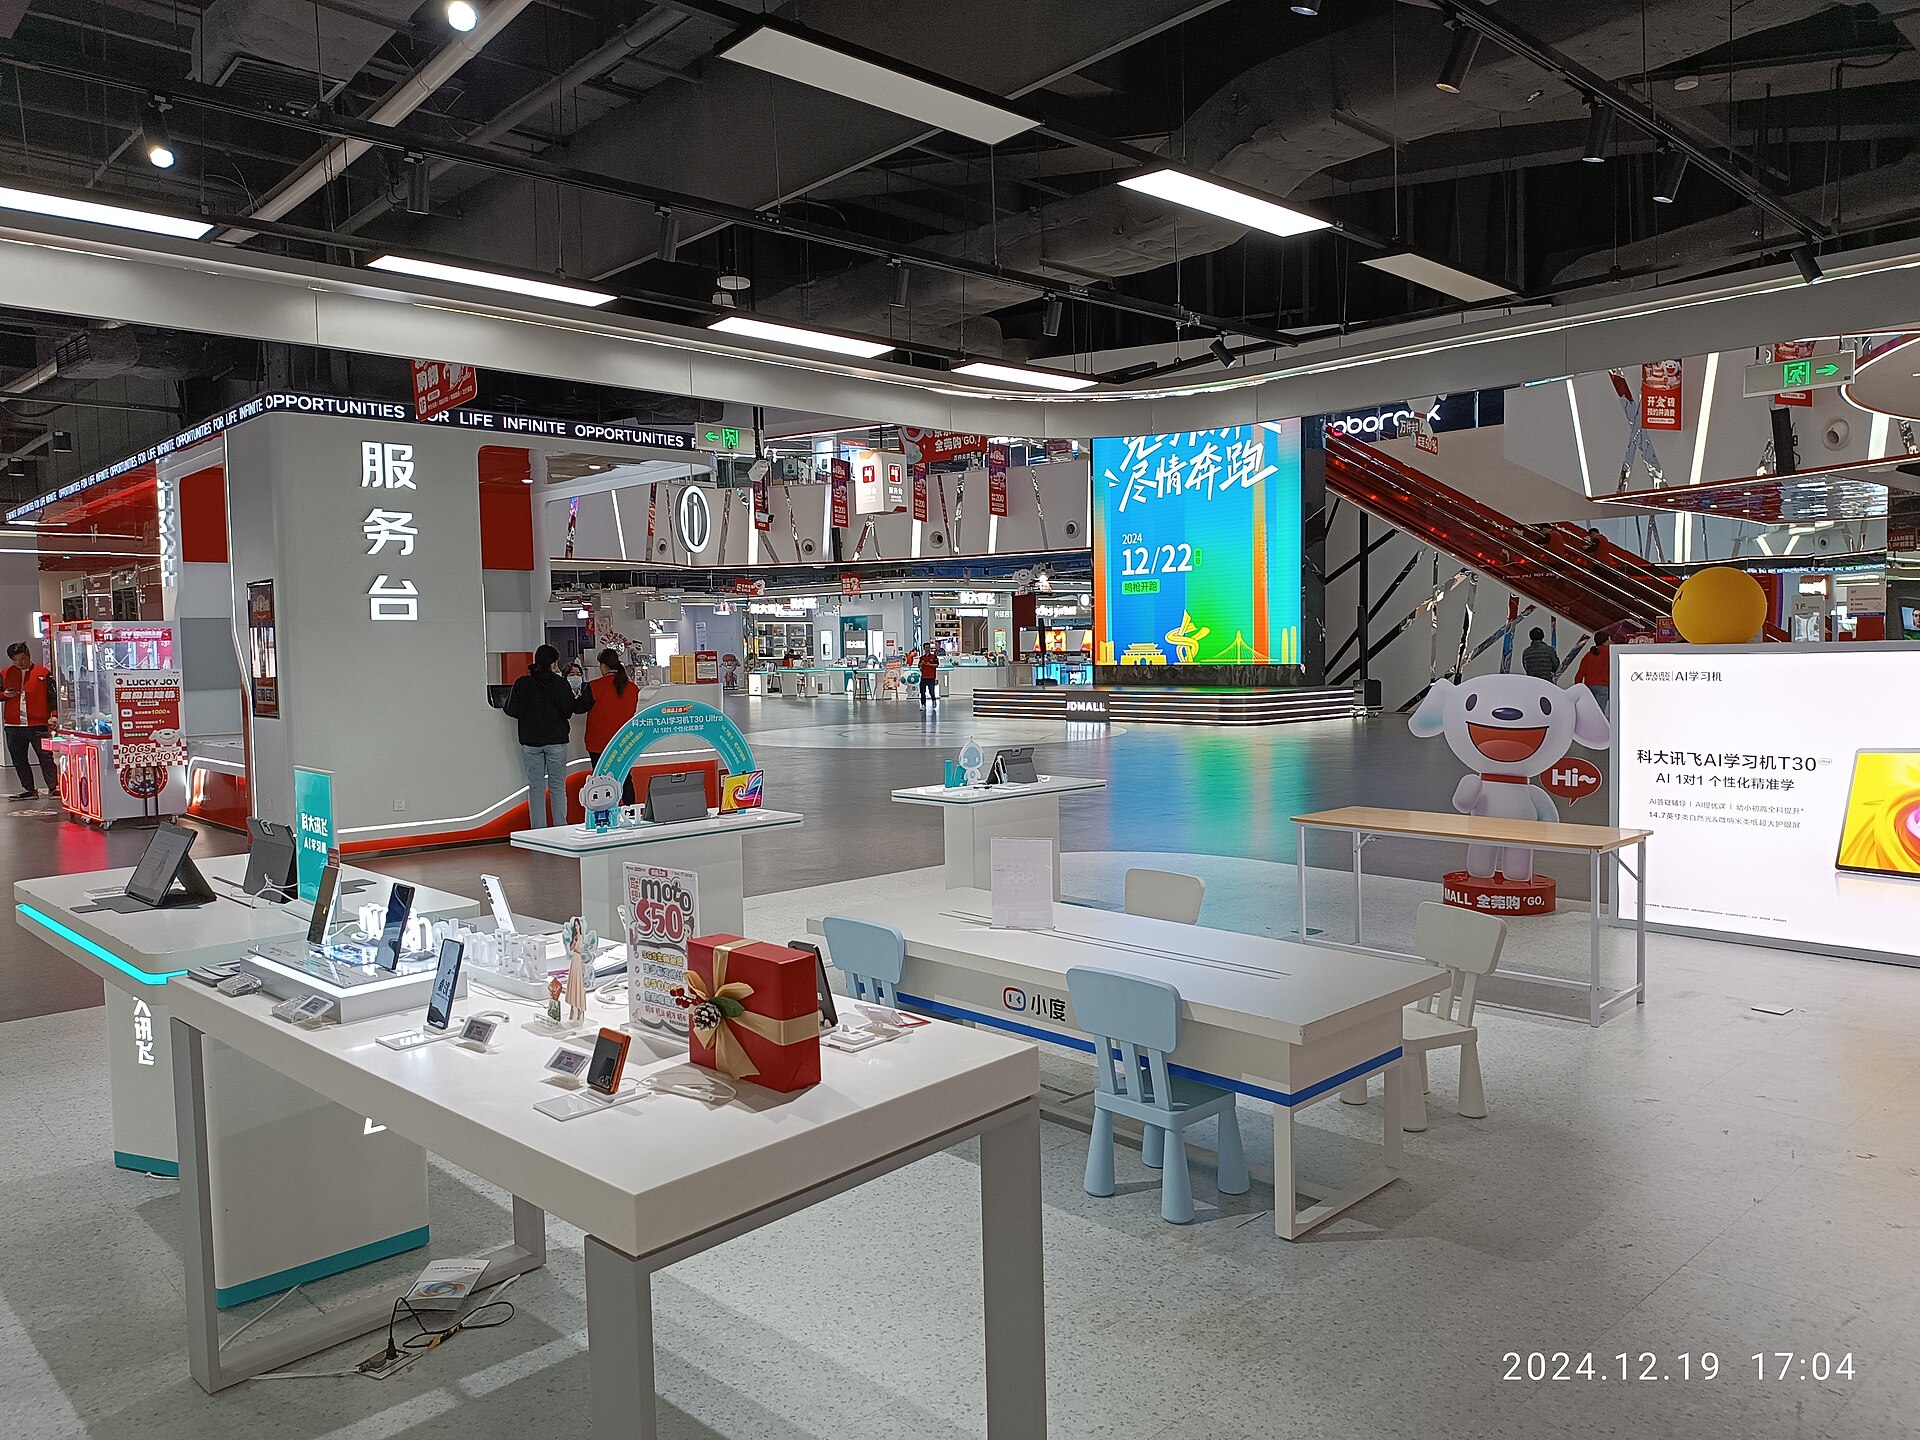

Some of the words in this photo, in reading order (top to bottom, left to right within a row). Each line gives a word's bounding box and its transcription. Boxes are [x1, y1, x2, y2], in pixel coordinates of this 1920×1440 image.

[138, 452, 146, 464] FOR
[147, 447, 156, 460] LIFE
[157, 439, 175, 456] INFINITE
[176, 422, 211, 448] OPPORTUNITIES
[213, 416, 224, 431] FOR
[226, 409, 237, 425] LIFE
[239, 398, 263, 420] INFINITE
[265, 394, 405, 419] OPPORTUNITIES
[459, 411, 494, 427] LIFE
[503, 416, 566, 435] INFINITE
[575, 424, 684, 448] OPPORTUNITIES
[1119, 440, 1279, 513] 尽情奔跑
[361, 441, 418, 621] 服务台
[1121, 533, 1143, 545] 2024
[1121, 543, 1193, 576] 12/22
[1124, 581, 1158, 593] 鸣枪开跑
[126, 679, 158, 687] LUCKY
[160, 678, 179, 686] JOY
[1675, 671, 1722, 681] AI学习机
[631, 715, 703, 727] 科大讯飞AI学习机T30
[121, 744, 151, 754] DOGS
[1637, 750, 1816, 771] 科大讯飞AI学习机T30
[1656, 773, 1670, 783] AI
[1675, 774, 1703, 786] 1对1
[1709, 775, 1795, 791] 个性化精准学
[641, 879, 692, 912] moto
[636, 898, 683, 939] S50
[1031, 994, 1065, 1022] 小度
